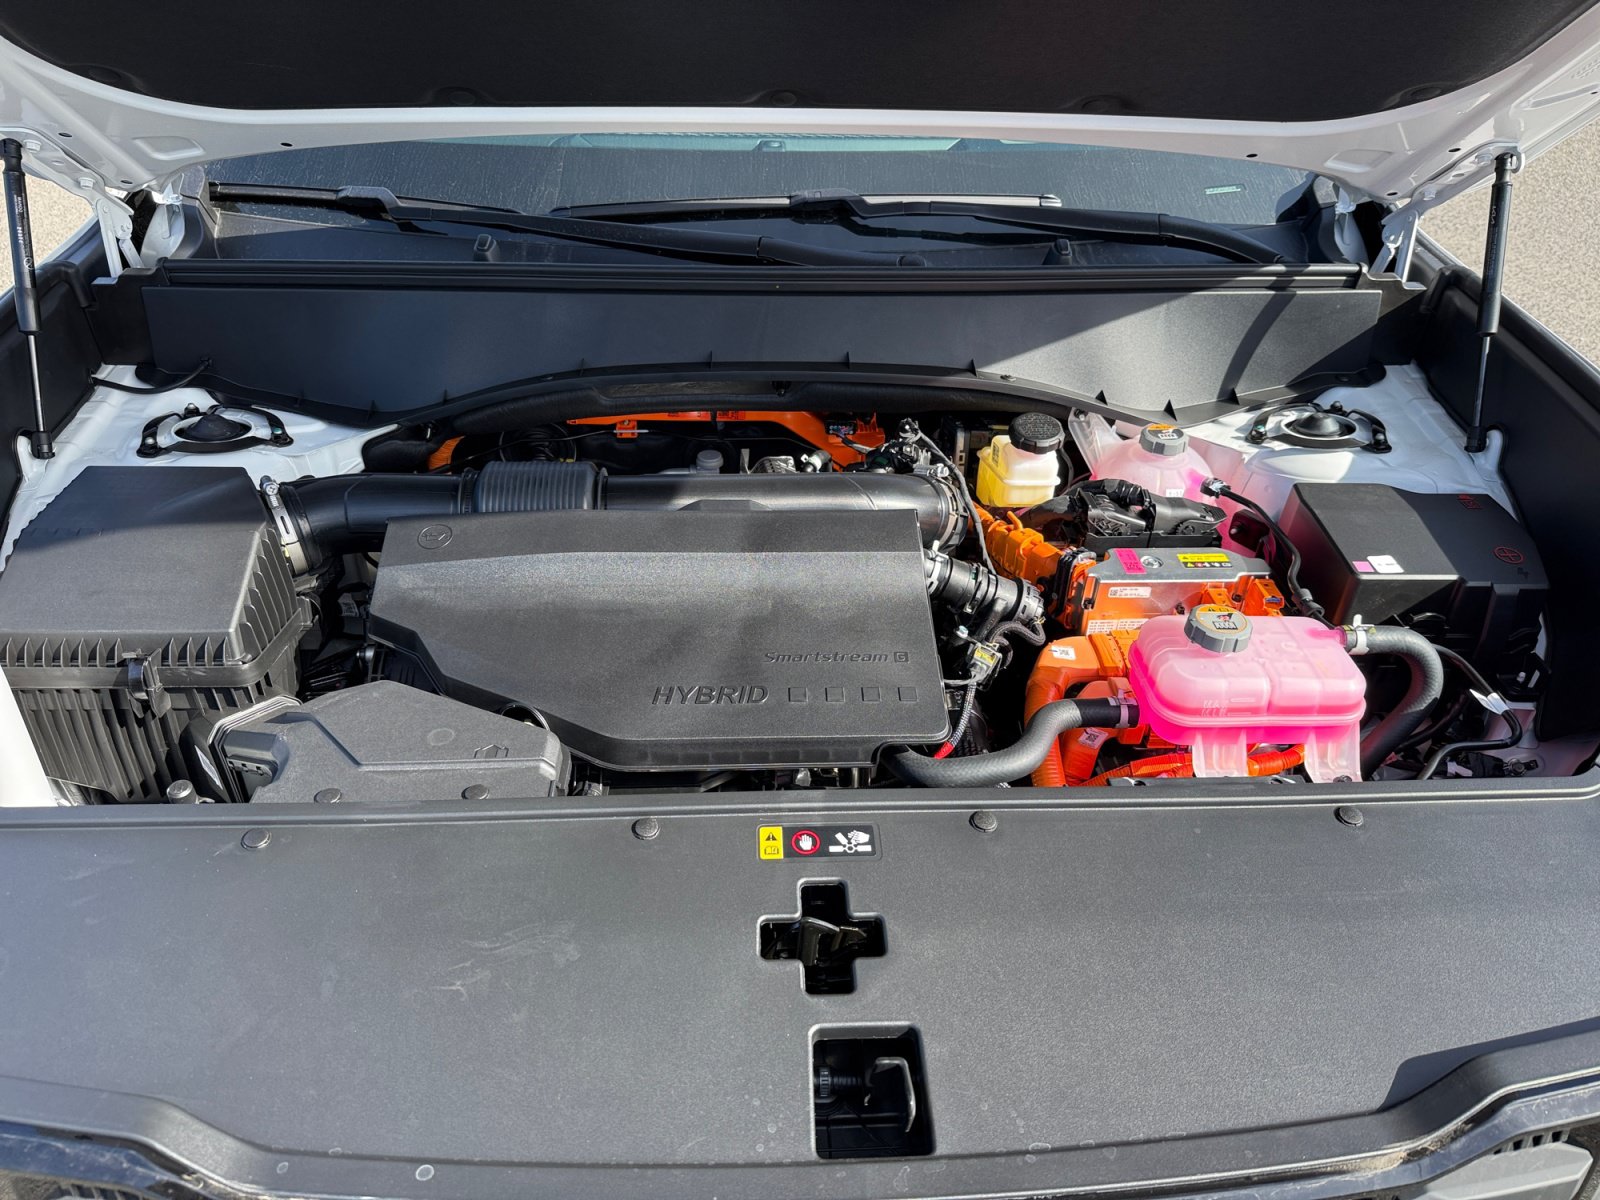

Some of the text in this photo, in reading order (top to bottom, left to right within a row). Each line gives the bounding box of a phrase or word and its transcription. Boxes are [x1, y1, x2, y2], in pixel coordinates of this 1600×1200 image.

[764, 651, 909, 663] Smartstream G
[651, 685, 770, 705] HYBRID
